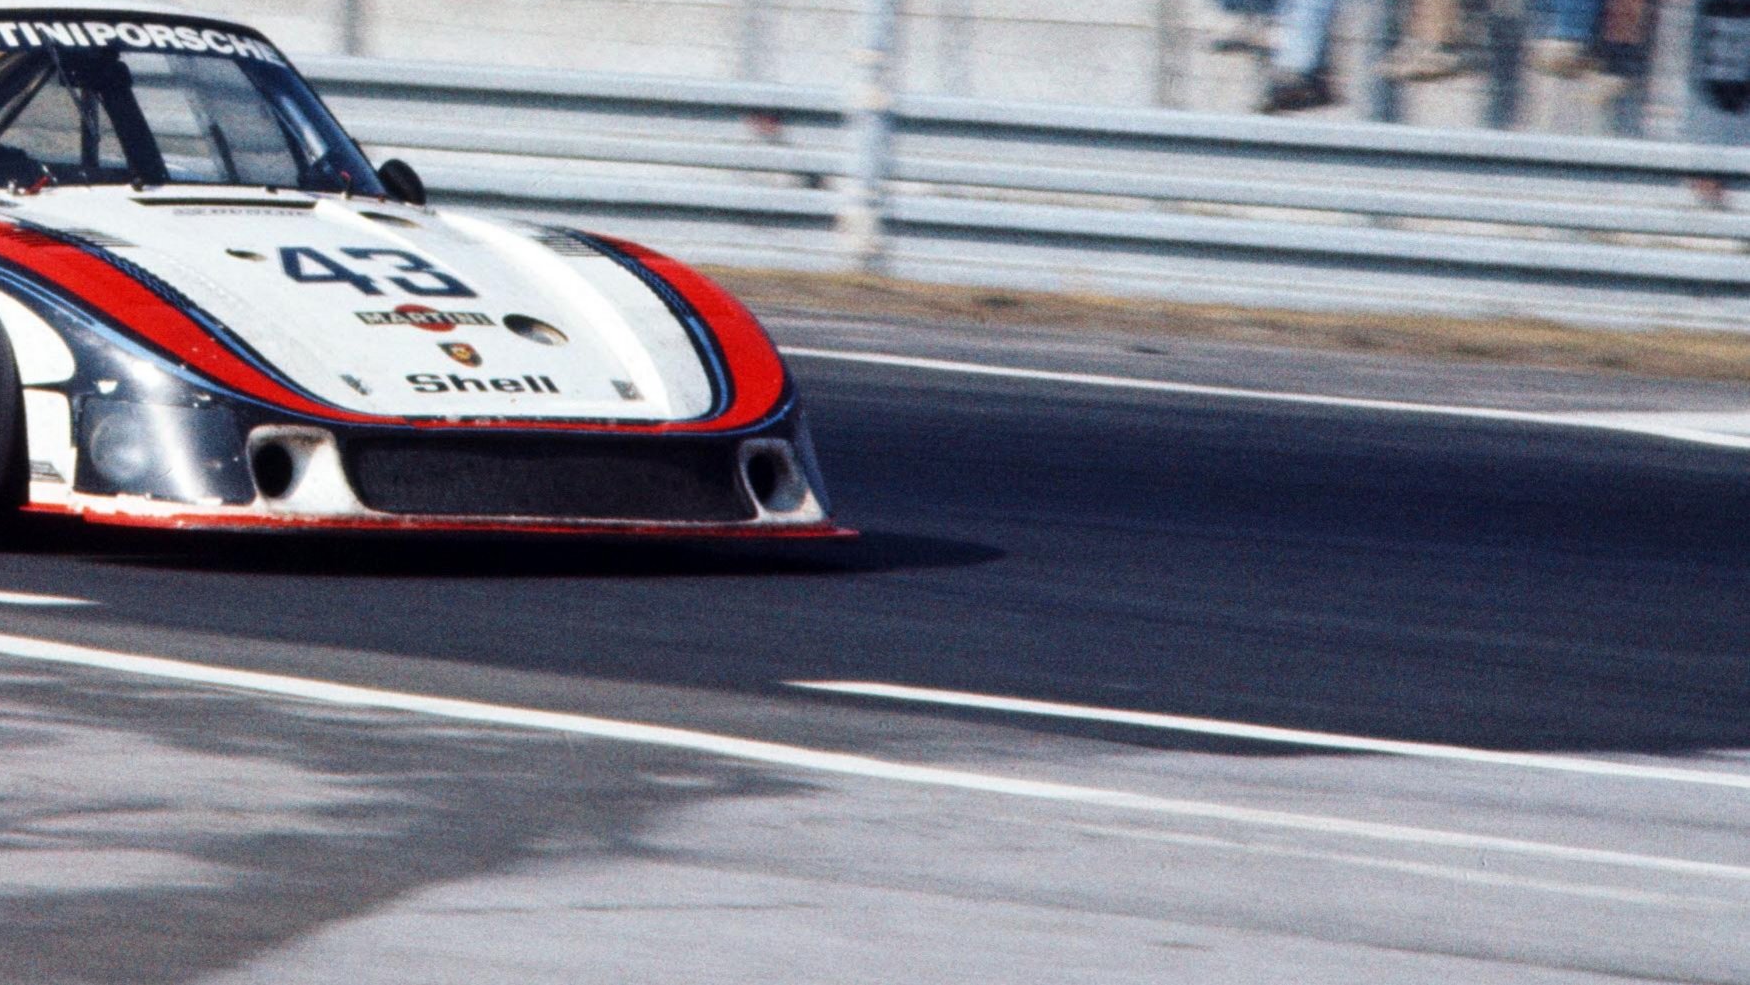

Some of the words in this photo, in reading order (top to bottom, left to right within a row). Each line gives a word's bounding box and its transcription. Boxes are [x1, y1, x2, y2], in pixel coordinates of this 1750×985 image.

[278, 246, 479, 298] 43
[356, 312, 494, 326] MARTINI
[406, 373, 560, 394] Shell
